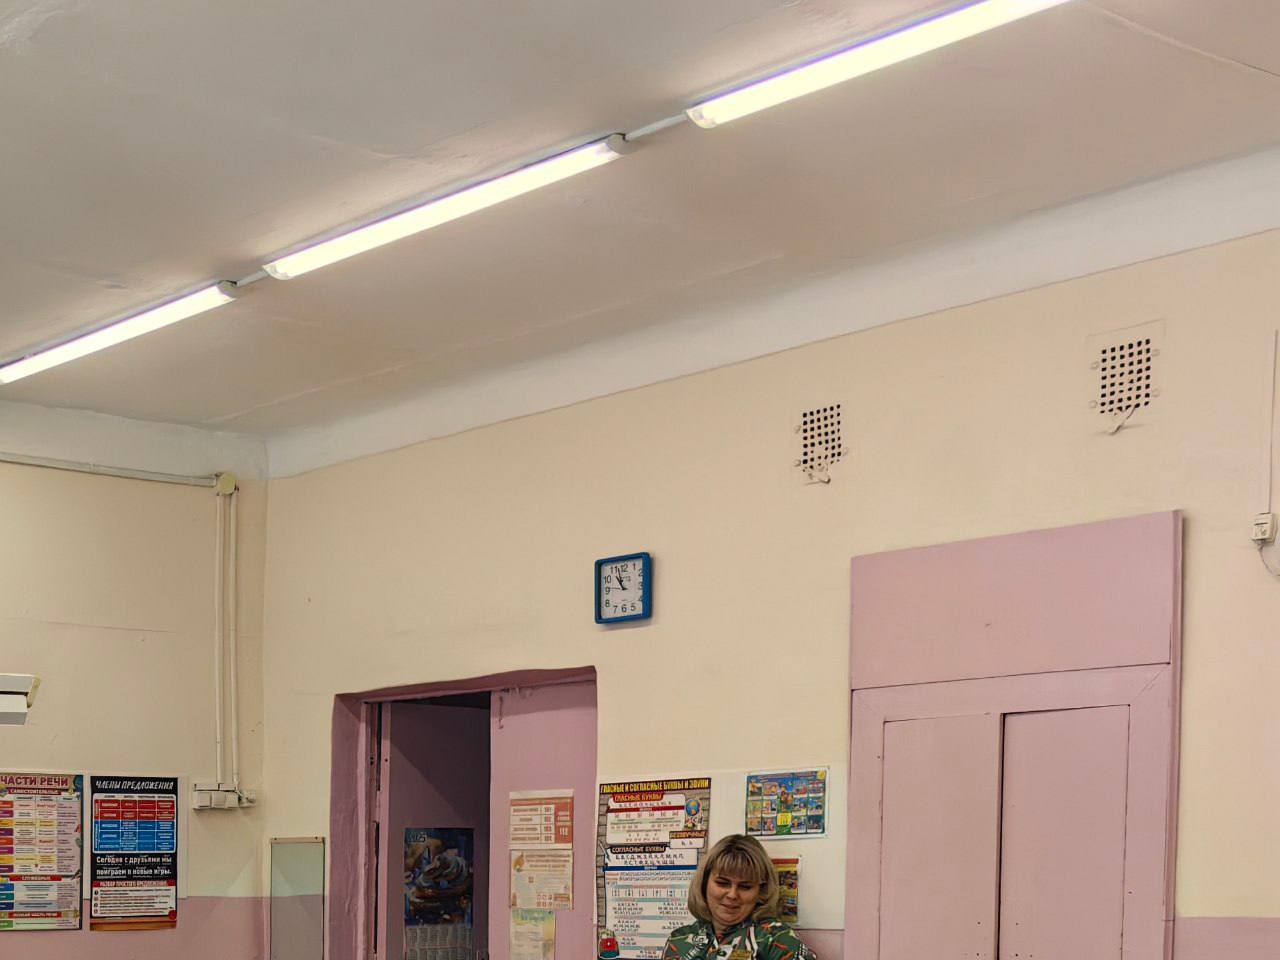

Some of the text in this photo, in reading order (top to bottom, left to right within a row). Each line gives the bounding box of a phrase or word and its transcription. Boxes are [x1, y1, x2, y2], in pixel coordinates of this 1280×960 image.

[0, 776, 69, 787] ЧАСТИ РЕЧИ
[95, 781, 174, 790] ЧЛЕНЫ ПРЕДЛОЖЕНИЯ
[96, 868, 126, 876] поиграем
